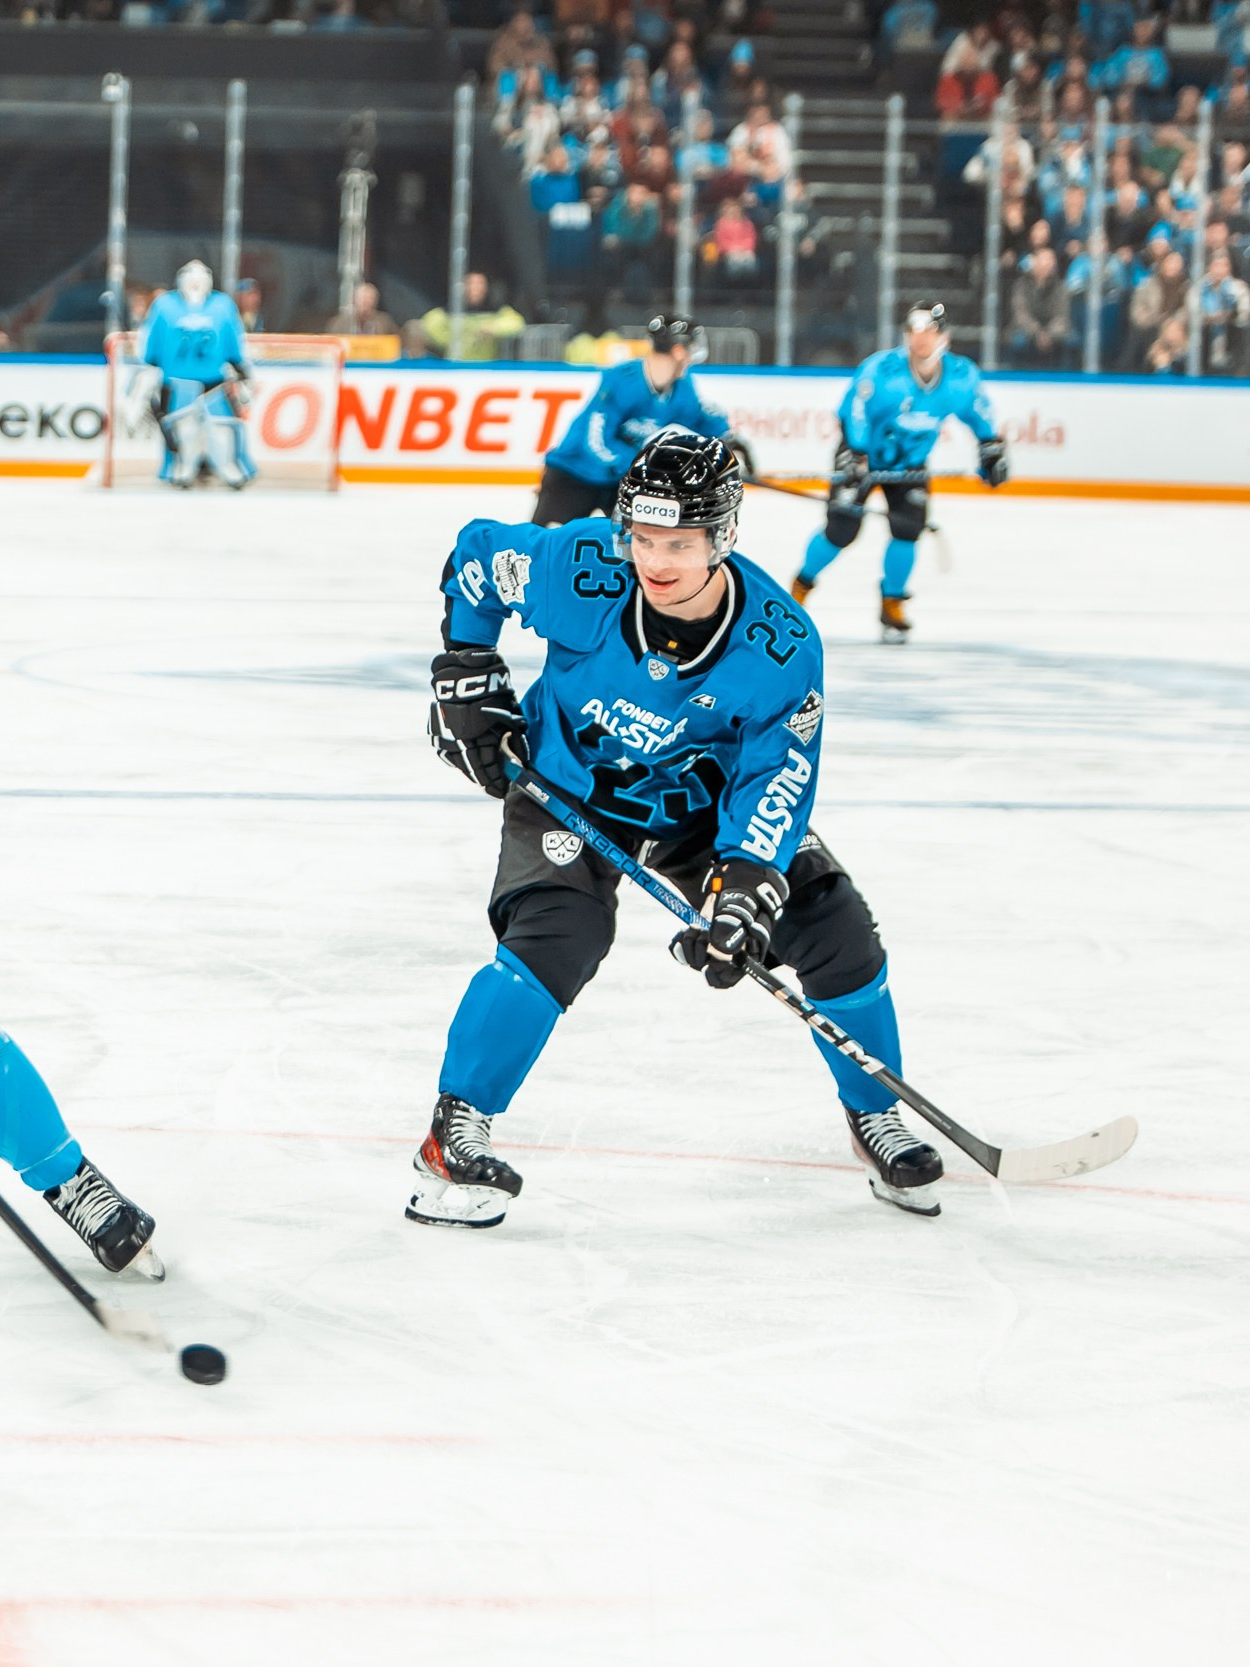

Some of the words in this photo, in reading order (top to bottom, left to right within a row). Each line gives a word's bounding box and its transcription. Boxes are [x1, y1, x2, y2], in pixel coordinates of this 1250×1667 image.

[248, 383, 582, 453] ONBET
[635, 503, 677, 518] согаз
[574, 538, 630, 599] 23
[746, 598, 808, 667] 23
[435, 672, 511, 700] CCM
[611, 698, 672, 732] FONBET
[740, 796, 794, 862] STA
